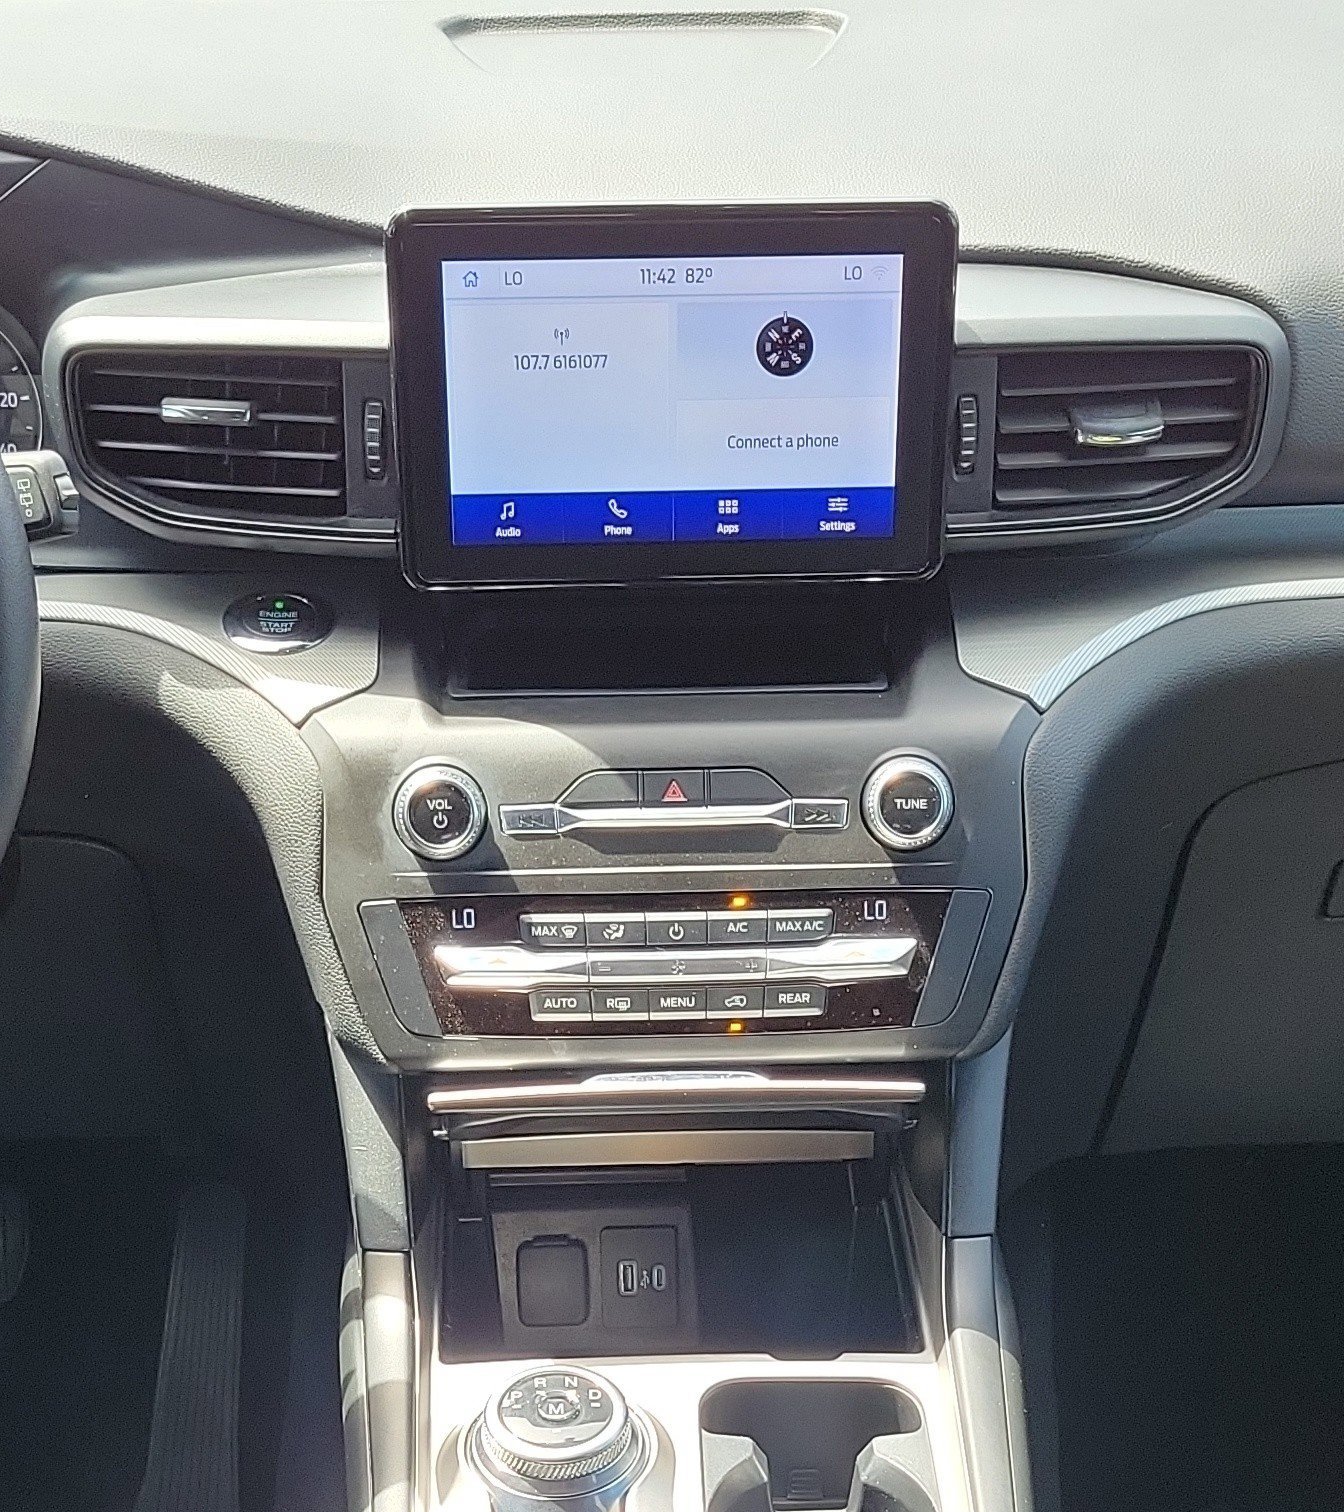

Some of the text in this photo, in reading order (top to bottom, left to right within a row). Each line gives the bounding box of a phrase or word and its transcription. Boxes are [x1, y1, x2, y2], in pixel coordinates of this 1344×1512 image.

[504, 271, 523, 286] LO
[640, 267, 713, 284] 11:42 82°
[843, 265, 862, 281] LO
[513, 353, 608, 371] 107.7 6161077
[727, 434, 839, 450] Connect a phone
[495, 526, 521, 537] Audio
[604, 525, 632, 536] Phone
[716, 522, 739, 534] Apps
[819, 520, 856, 532] Settings
[258, 610, 298, 618] ENGINE
[426, 799, 452, 811] VOL
[893, 797, 928, 810] TUNE
[863, 900, 887, 921] LO
[451, 908, 475, 929] LO
[531, 926, 557, 937] MAX
[726, 922, 748, 933] A/C
[775, 920, 824, 932] MAX A/C
[543, 997, 577, 1009] AUTO
[660, 996, 696, 1008] MENU
[778, 993, 811, 1004] REAR
[533, 1377, 547, 1388] R
[564, 1376, 578, 1387] N
[588, 1389, 602, 1400] D
[548, 1403, 565, 1415] M
